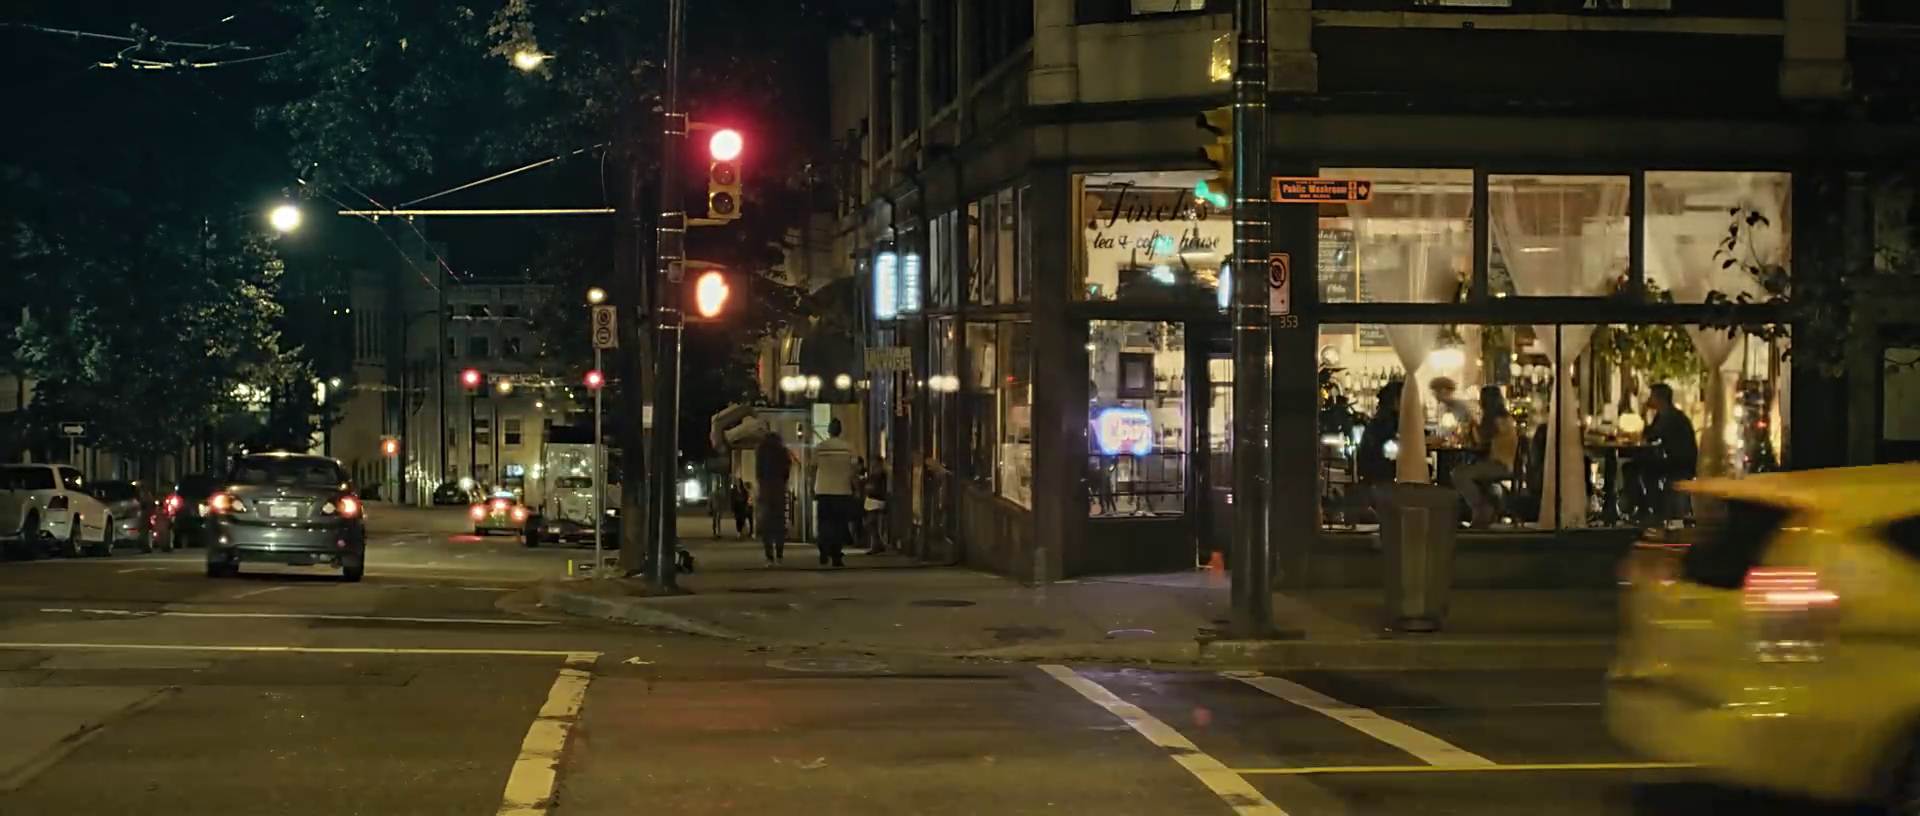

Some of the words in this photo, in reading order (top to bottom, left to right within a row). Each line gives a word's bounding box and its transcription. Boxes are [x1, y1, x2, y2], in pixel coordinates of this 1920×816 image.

[1282, 183, 1307, 193] Public
[1097, 180, 1208, 229] Finchs
[1093, 231, 1114, 249] tea
[1179, 228, 1220, 249] house
[1280, 315, 1299, 329] 353
